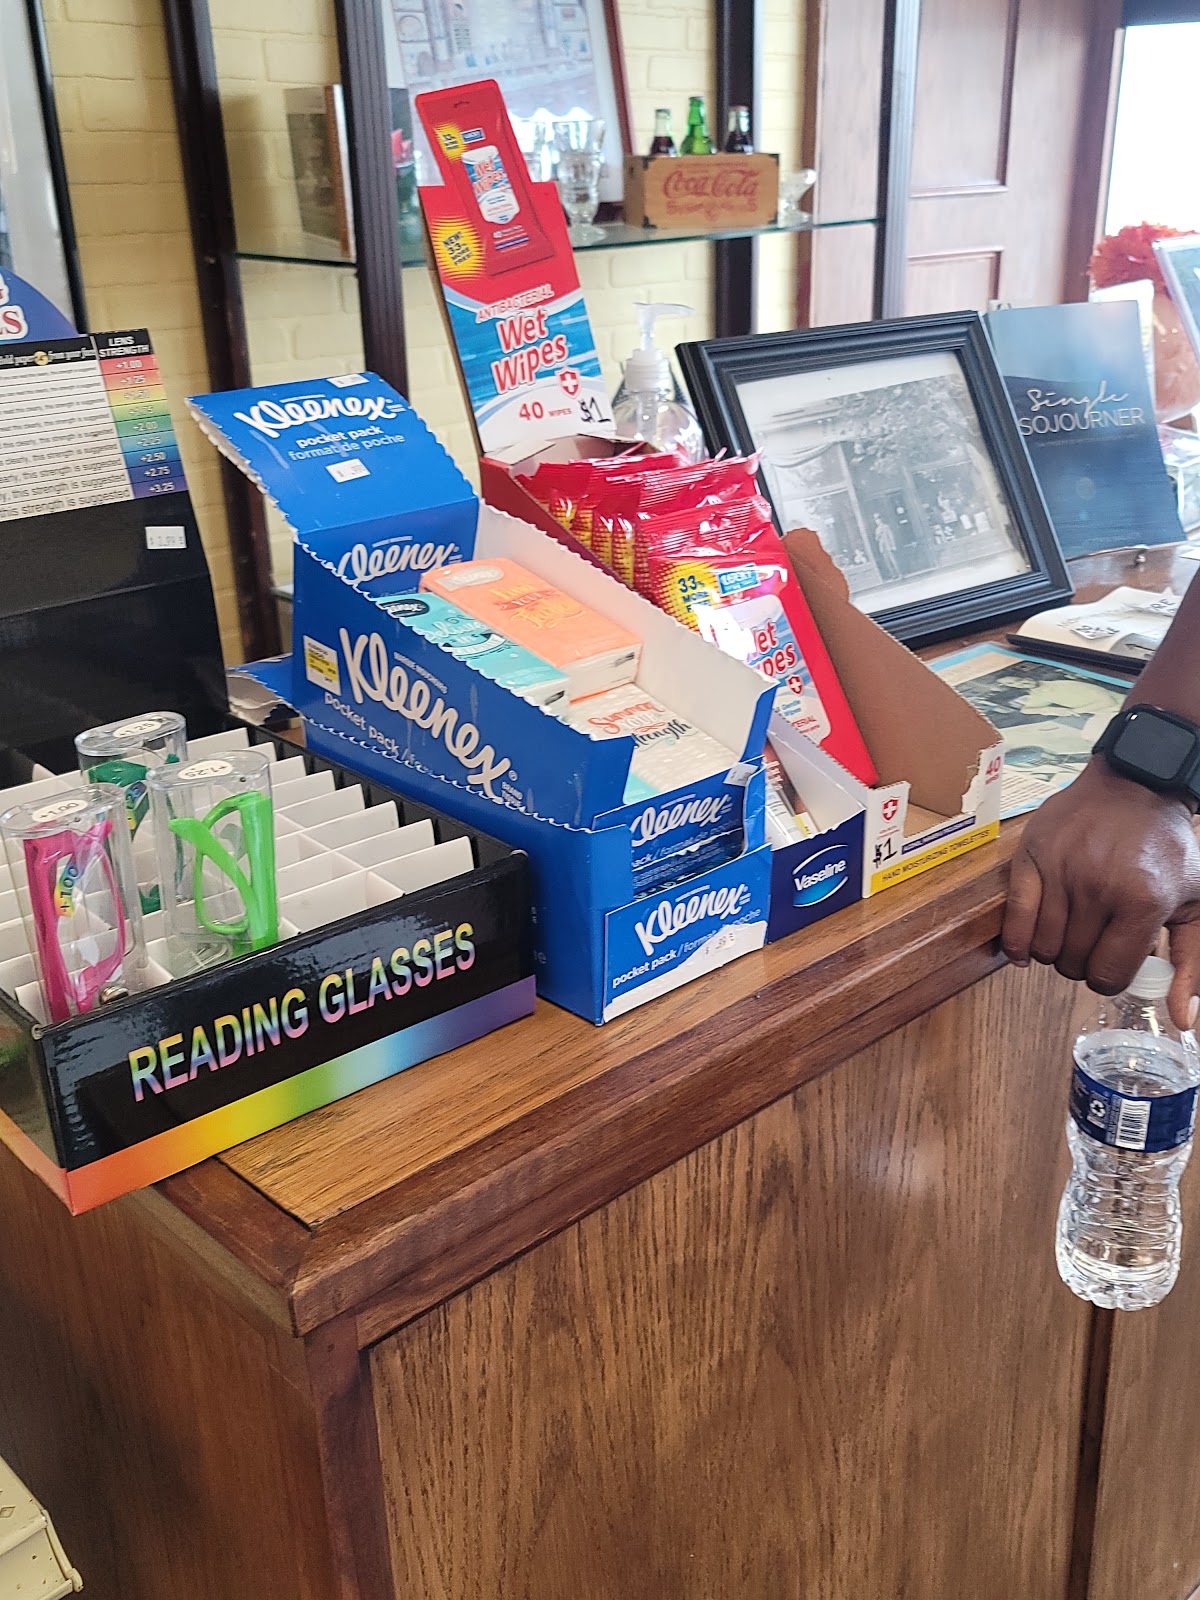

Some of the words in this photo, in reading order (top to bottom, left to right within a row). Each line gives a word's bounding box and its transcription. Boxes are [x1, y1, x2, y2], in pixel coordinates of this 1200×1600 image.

[476, 284, 555, 321] ANTIBACTERIAL
[109, 337, 134, 347] LENS
[499, 307, 548, 353] Wet
[99, 345, 149, 358] STRENGTH
[494, 336, 567, 392] Wipes
[519, 401, 544, 420] 40
[549, 408, 572, 417] WIPES
[578, 396, 611, 423] $1
[1027, 380, 1130, 419] Single
[233, 396, 397, 439] Kleenex
[1019, 407, 1145, 437] SOJOURNER
[288, 444, 340, 462] format
[343, 440, 360, 452] de
[363, 433, 405, 450] poche
[296, 430, 346, 449] pocket
[348, 425, 384, 441] pack
[22, 471, 38, 479] this
[40, 466, 72, 476] strength
[83, 458, 122, 471] suggested
[140, 452, 166, 462] +2.50
[144, 466, 170, 477] +2.75
[12, 488, 29, 498] this
[31, 483, 69, 496] strength
[71, 480, 79, 489] is
[81, 473, 126, 488] suggested
[21, 499, 64, 514] strength
[66, 497, 76, 507] is
[78, 488, 131, 506] suggested
[753, 619, 778, 654] et
[324, 691, 366, 730] pocket
[368, 725, 399, 759] pack
[338, 627, 511, 804] Kleenex
[587, 702, 665, 734] Summon
[985, 755, 1002, 776] 40
[872, 837, 899, 869] $1
[882, 868, 901, 882] HAND
[902, 847, 949, 873] MOISTURIZING
[949, 829, 991, 853] TOWELETTES
[794, 858, 847, 891] Vaseline
[634, 883, 745, 957] Kleenex
[612, 962, 650, 988] pocket
[651, 948, 677, 971] pack
[127, 987, 310, 1103] READING
[318, 921, 476, 1024] GLASSES
